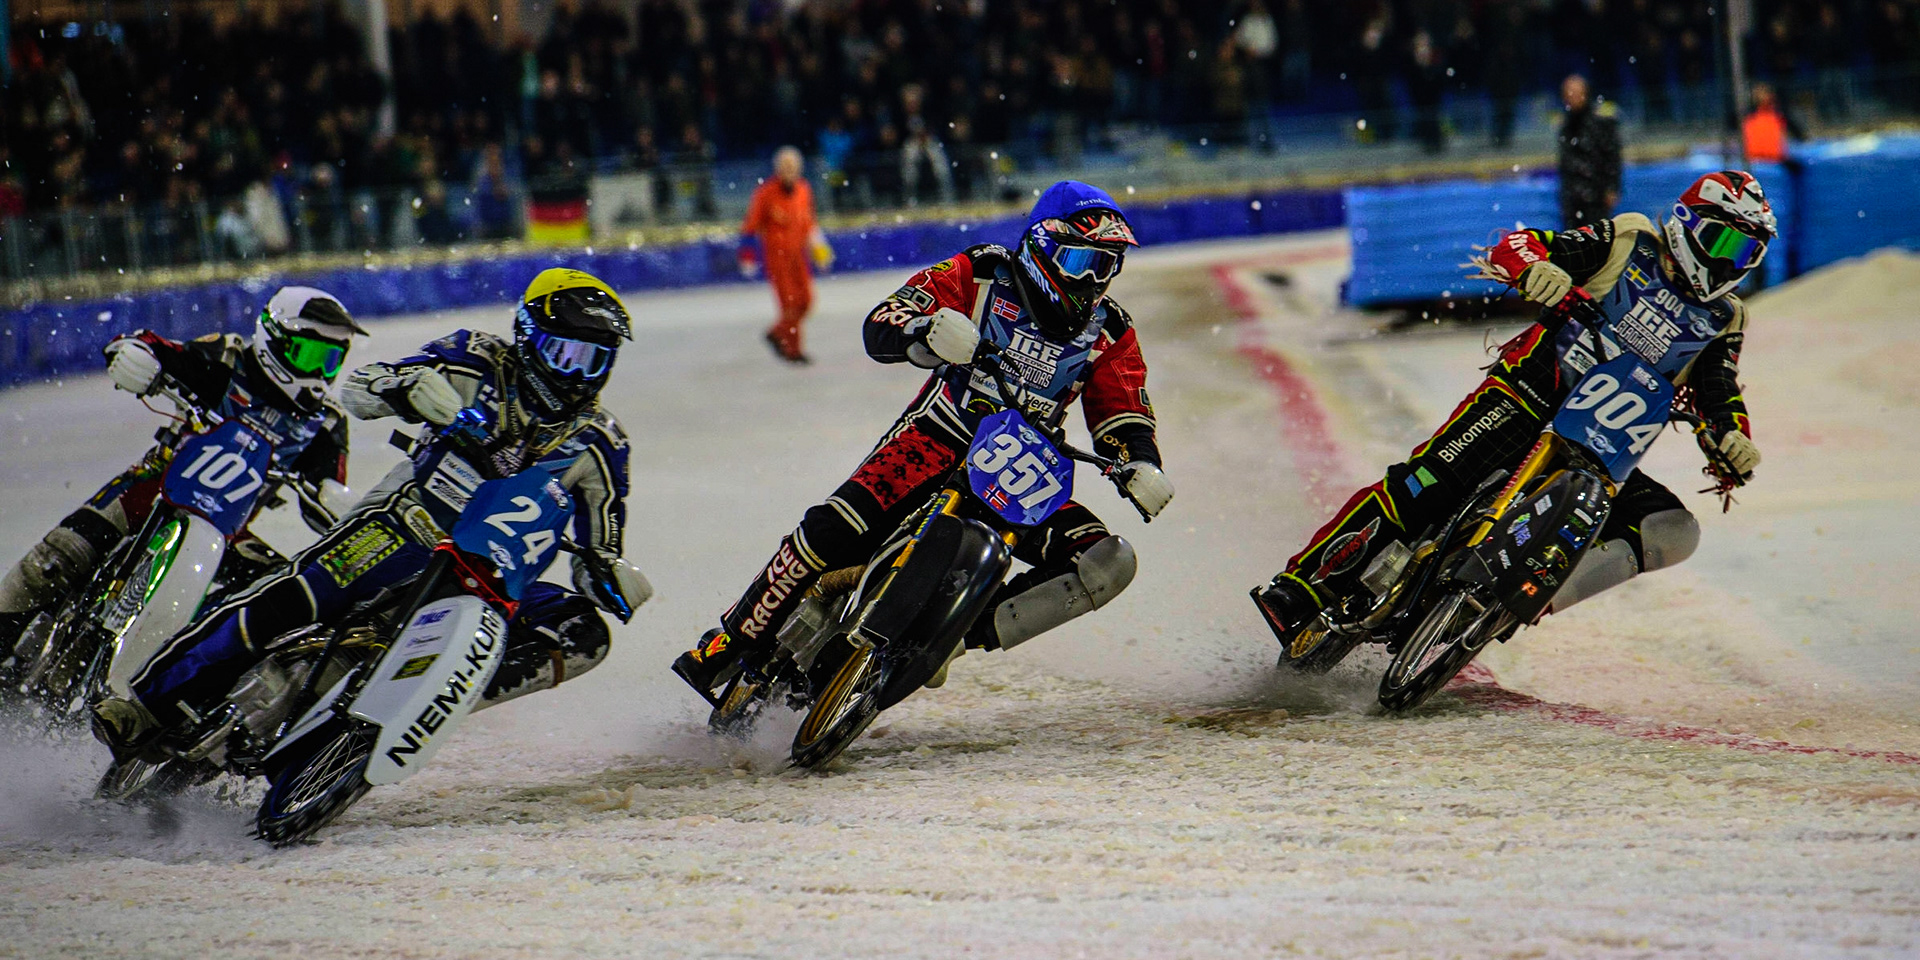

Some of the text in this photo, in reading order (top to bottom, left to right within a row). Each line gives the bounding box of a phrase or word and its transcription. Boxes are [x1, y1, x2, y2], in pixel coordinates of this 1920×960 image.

[1629, 300, 1682, 347] ICE
[1654, 288, 1686, 319] 904
[1008, 329, 1064, 368] ICE
[1625, 315, 1669, 352] SPEEDWAY
[1006, 350, 1055, 374] SPEEDWAY
[1565, 373, 1664, 456] 904
[180, 444, 264, 504] 107
[972, 433, 1064, 511] 357
[483, 495, 556, 565] 24
[766, 542, 794, 584] ICE
[740, 558, 810, 640] RACING
